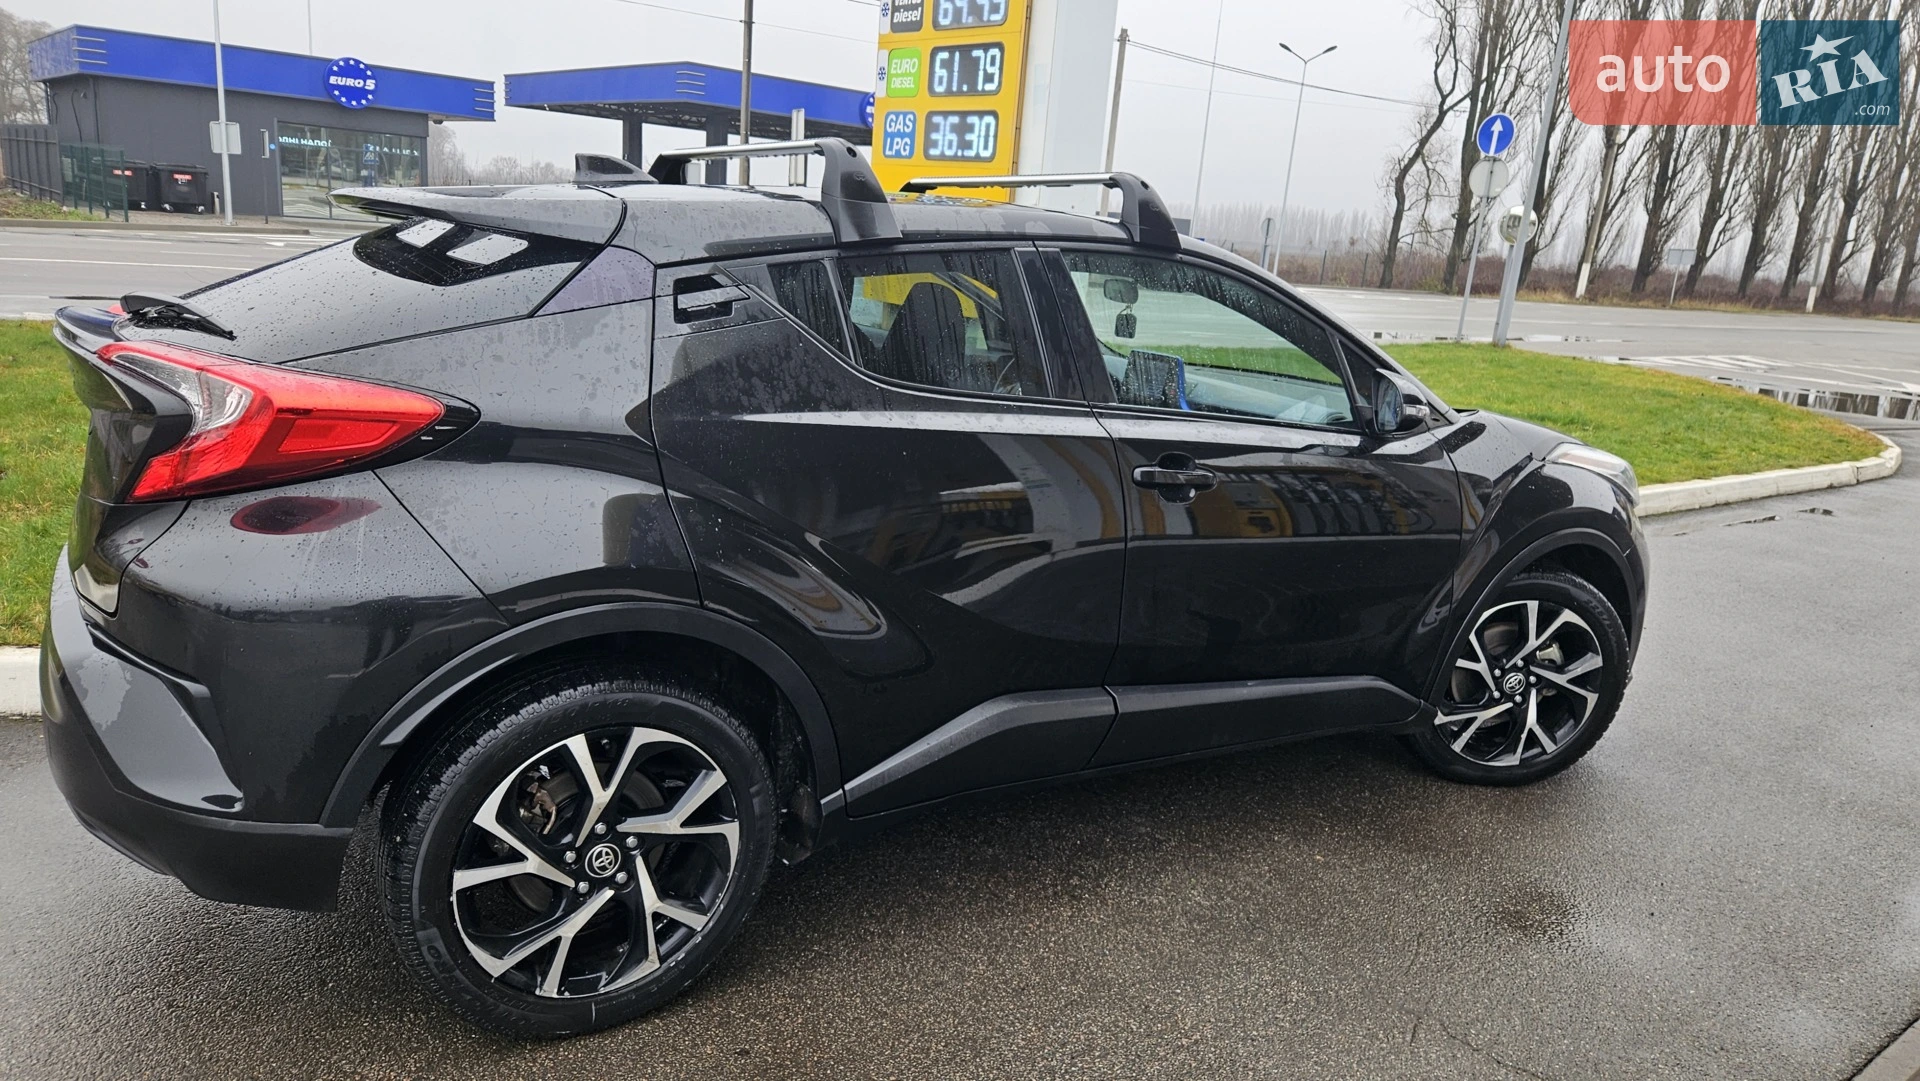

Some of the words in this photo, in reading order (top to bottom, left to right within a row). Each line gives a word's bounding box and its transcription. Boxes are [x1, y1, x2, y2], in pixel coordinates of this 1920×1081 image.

[893, 7, 922, 23] Diesel
[890, 58, 918, 74] EURO
[933, 48, 1002, 93] 61.79
[329, 75, 364, 88] EURO
[364, 79, 376, 90] 5
[891, 77, 915, 89] DIESEL
[886, 113, 913, 133] GAS
[929, 115, 997, 158] 36.30
[885, 137, 911, 156] LPG
